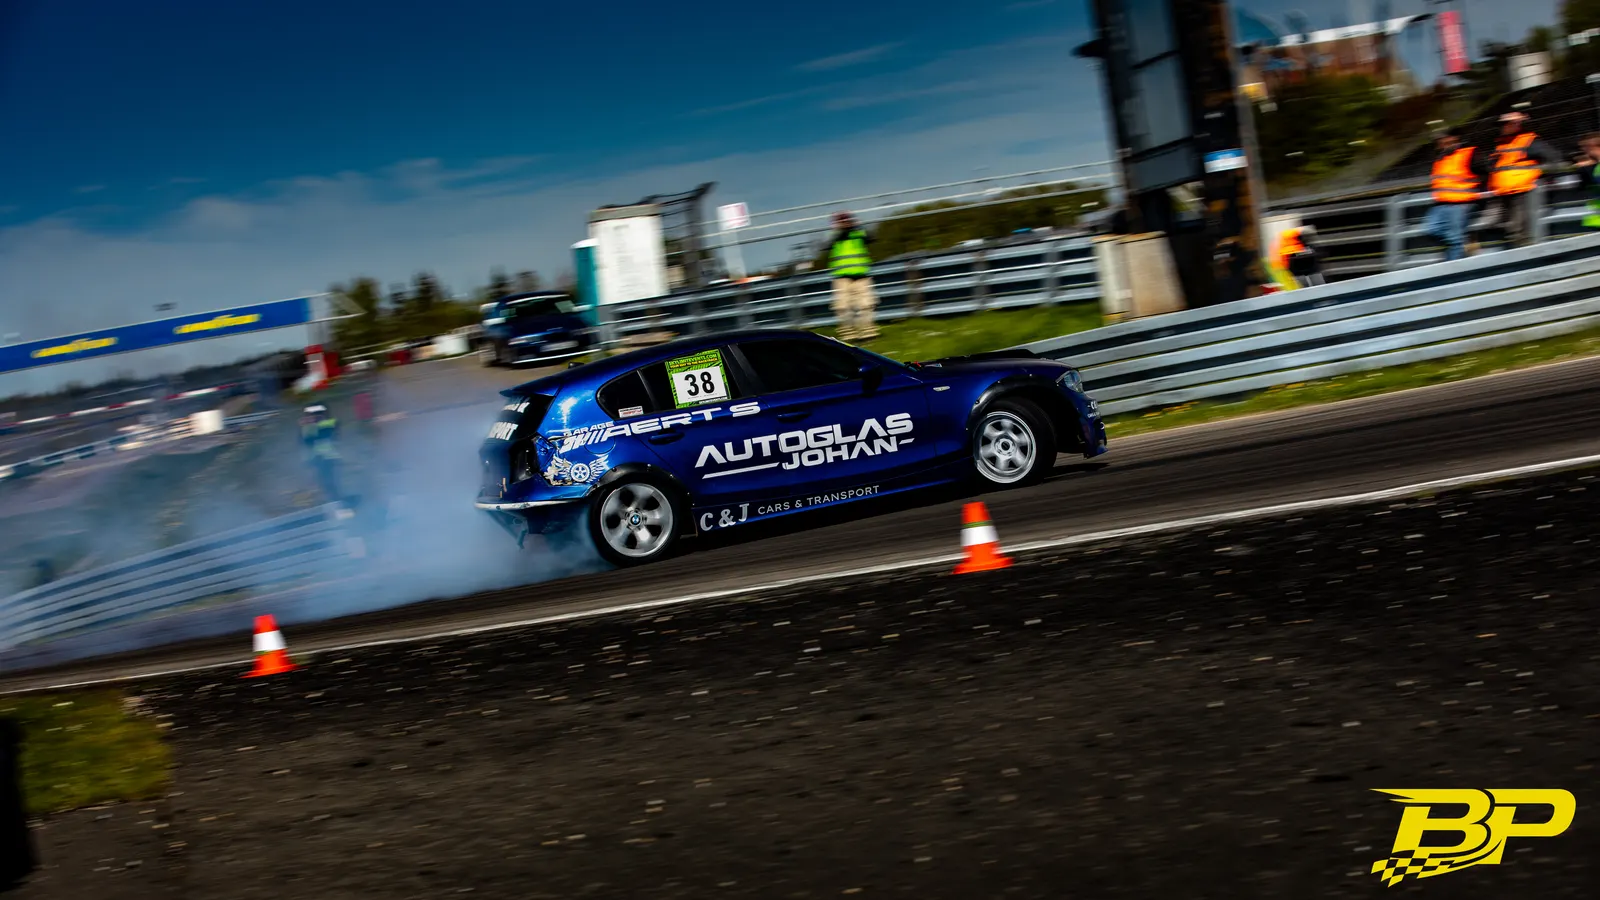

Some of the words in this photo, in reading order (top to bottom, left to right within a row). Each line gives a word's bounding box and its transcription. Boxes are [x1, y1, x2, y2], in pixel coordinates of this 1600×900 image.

[684, 371, 715, 396] 38
[694, 412, 914, 469] AUTOGLAS
[782, 436, 899, 470] JOHAN
[700, 512, 714, 532] C
[718, 508, 737, 529] &
[739, 503, 750, 523] J
[757, 503, 790, 515] CARS
[794, 500, 803, 508] &
[806, 485, 880, 506] TRANSPORT
